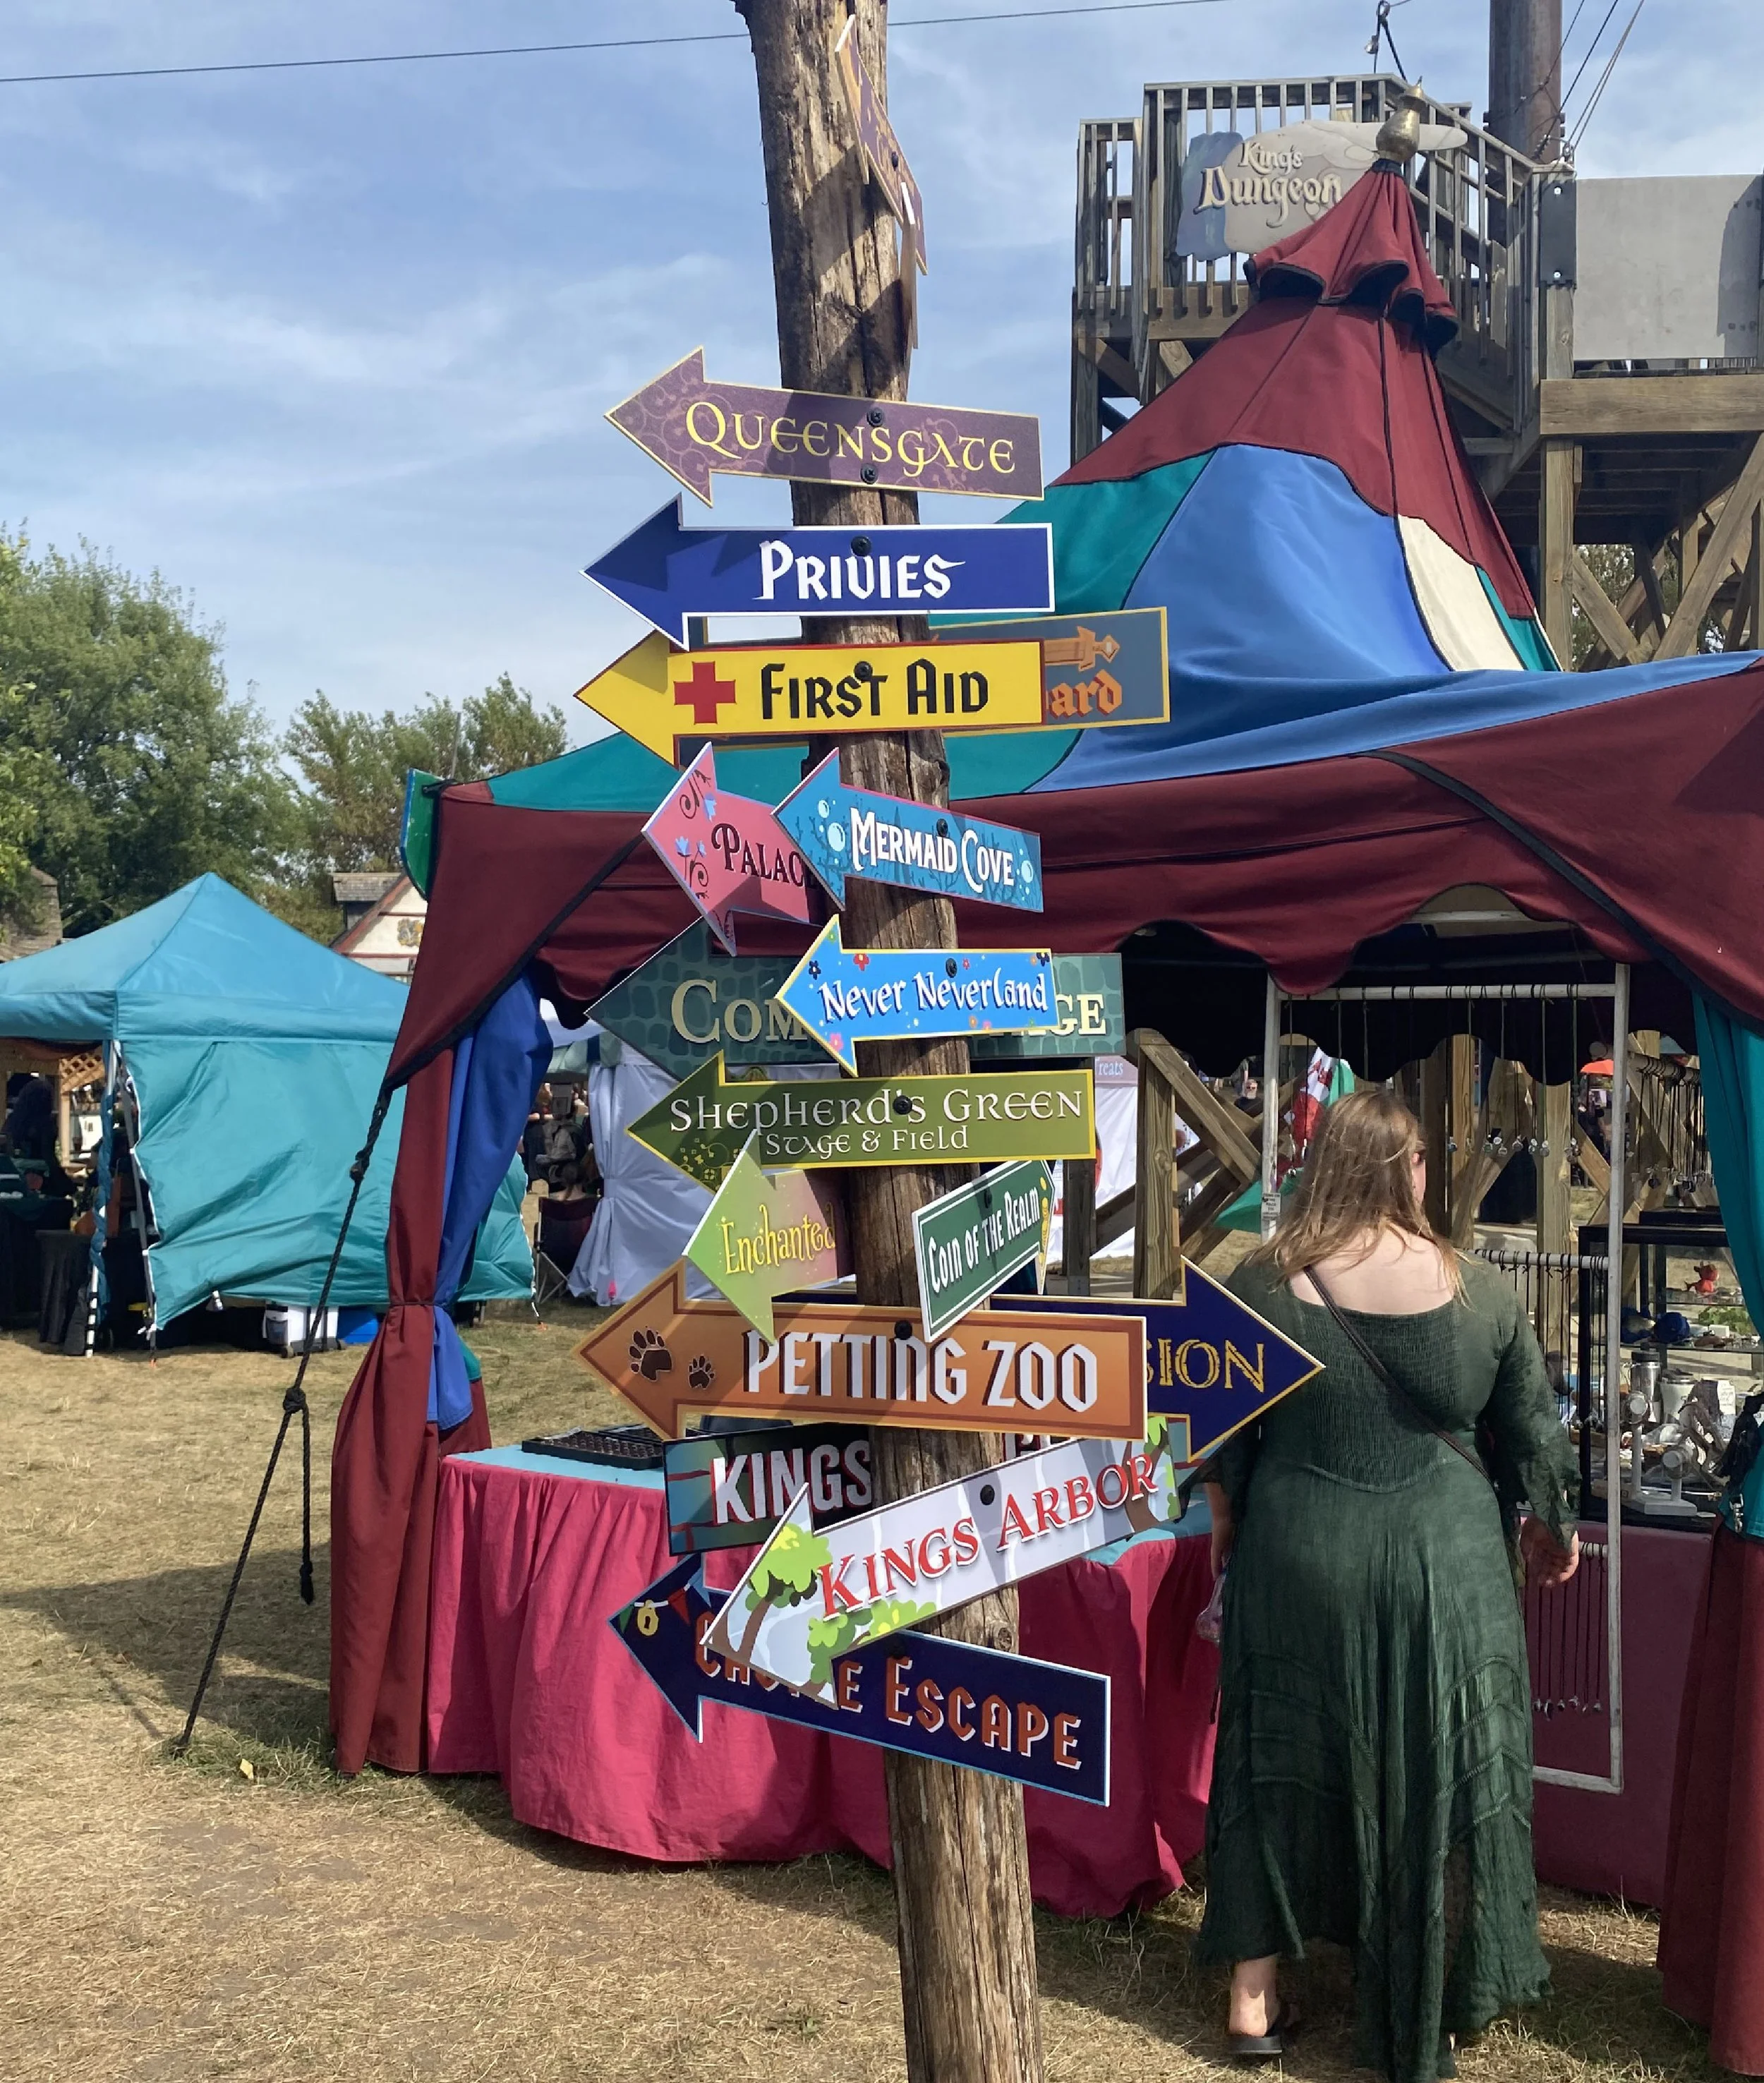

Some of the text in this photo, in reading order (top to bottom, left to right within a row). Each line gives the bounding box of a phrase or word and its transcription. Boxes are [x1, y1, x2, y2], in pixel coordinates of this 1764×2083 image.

[1238, 141, 1303, 176] King's
[1193, 166, 1342, 229] Dungeon
[752, 540, 966, 600] PRIVIES
[761, 658, 989, 720] FIRST AID
[1046, 669, 1123, 719] ard
[851, 807, 1016, 893] MERMAID COVE
[819, 967, 1049, 1023] Never Neverland
[1094, 1057, 1124, 1076] reats
[861, 1130, 882, 1152] &
[720, 1202, 836, 1275] Enchanted
[974, 1209, 1005, 1257] THE
[743, 1329, 1099, 1413] PETTING ZOO
[711, 1439, 872, 1525] KINGS
[817, 1452, 1161, 1622] KINGS ARBOR
[886, 1655, 1083, 1770] ESCAPE
